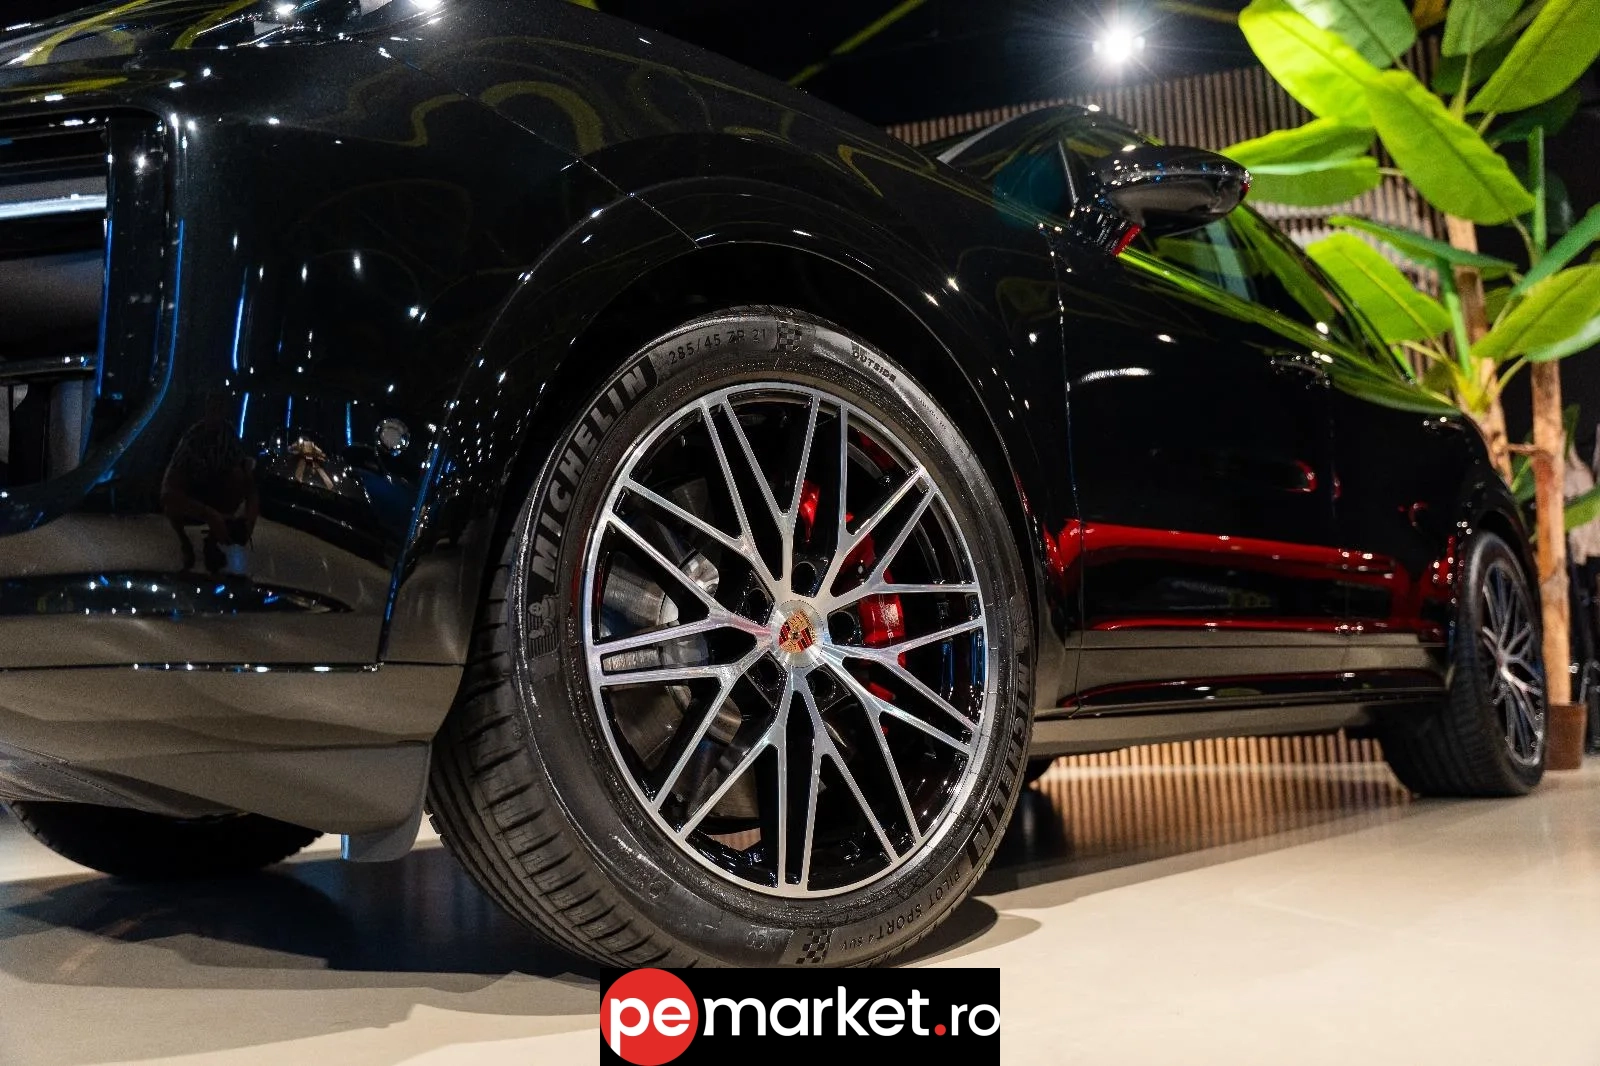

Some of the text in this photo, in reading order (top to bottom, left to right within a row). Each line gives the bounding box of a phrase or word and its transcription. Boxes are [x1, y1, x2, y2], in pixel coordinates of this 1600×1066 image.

[669, 332, 721, 364] 285/45
[752, 328, 767, 345] 21
[853, 349, 897, 383] OUTSIDE
[532, 365, 648, 583] MICHELIN
[972, 662, 1030, 857] MICHELIN
[928, 864, 961, 909] PILOT
[876, 904, 923, 940] SPORT
